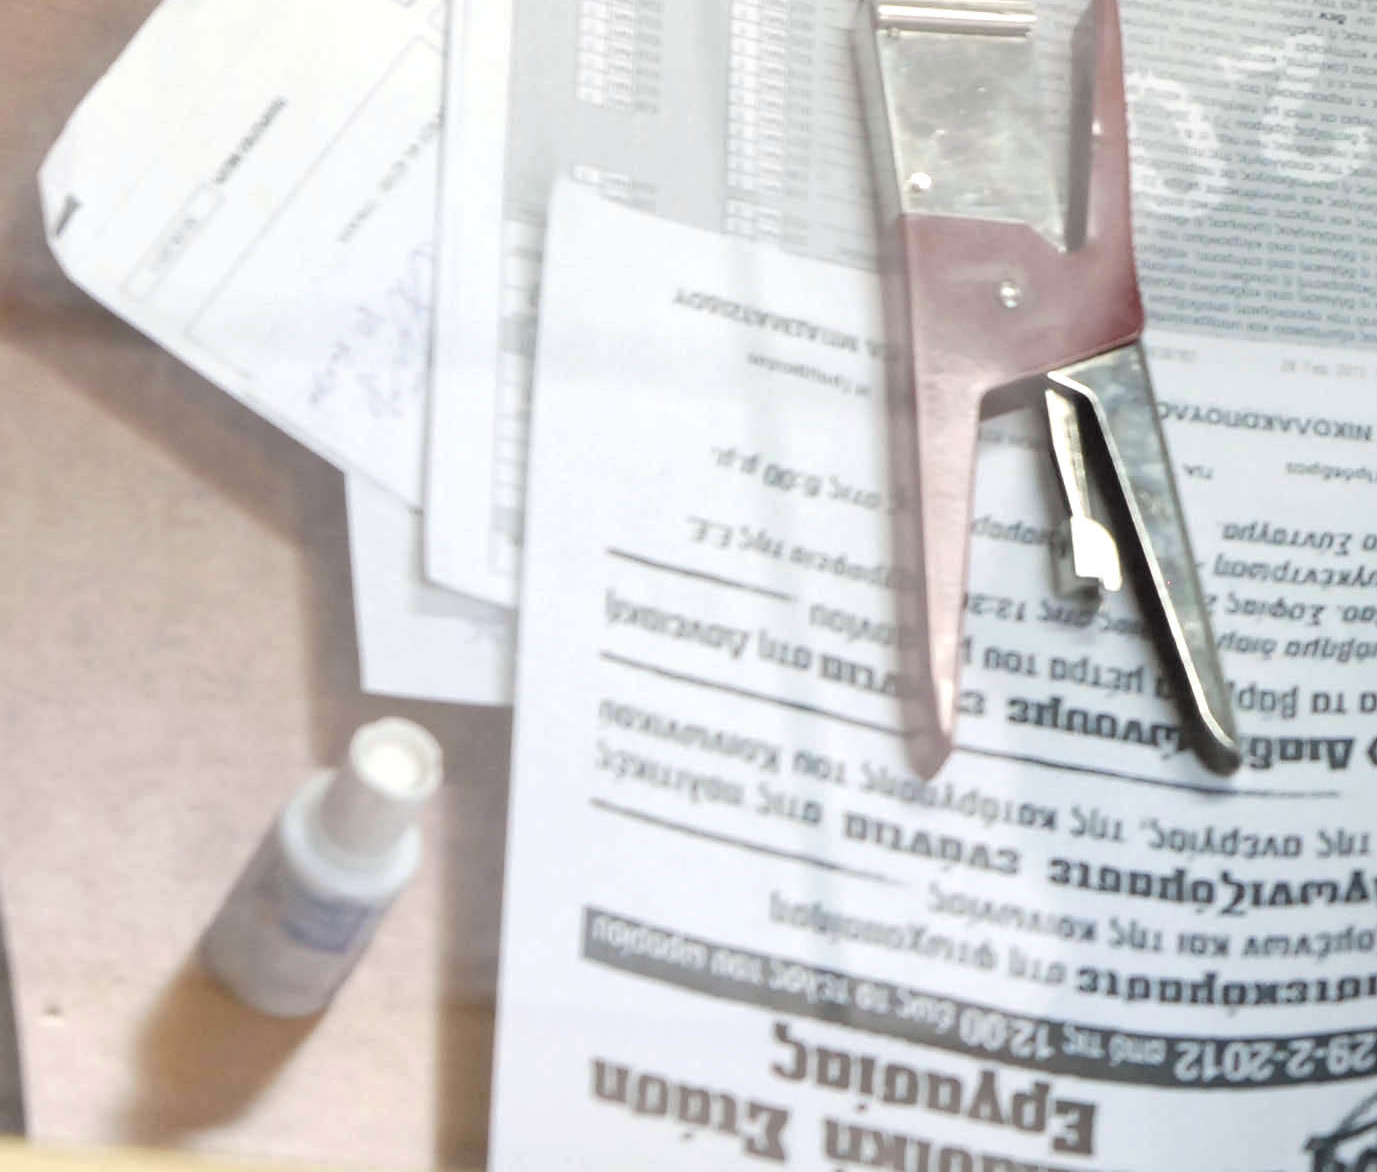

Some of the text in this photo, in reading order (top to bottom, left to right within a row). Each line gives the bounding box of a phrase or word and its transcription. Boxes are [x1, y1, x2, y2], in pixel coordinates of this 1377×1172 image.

[1156, 403, 1373, 442] ΝΙΚΟΛΑΚΟΠΟΥΛΟ
[962, 594, 1027, 624] 12:3
[1224, 592, 1326, 627] Σοφίας
[758, 629, 813, 672] στη
[982, 648, 1040, 682] του
[1049, 656, 1146, 700] μέτρα
[1310, 691, 1347, 716] τα
[1006, 696, 1355, 771] Διαδώνουμε
[794, 751, 848, 785] του
[756, 780, 824, 829] στις
[843, 812, 1022, 882] ενάντια
[1069, 805, 1127, 848] της
[1317, 828, 1373, 861] της
[929, 884, 1098, 945] κοινωνίας
[1108, 917, 1164, 953] της
[1178, 931, 1230, 956] και
[1009, 948, 1067, 987] στη
[895, 987, 956, 1032] έως
[959, 1006, 1054, 1060] 12:00
[1063, 1023, 1104, 1057] τις
[1108, 1034, 1168, 1066] από
[1174, 1030, 1377, 1081] 29-2-2012
[771, 1023, 1097, 1158] Εργασίας
[590, 1059, 789, 1164] Στάση
